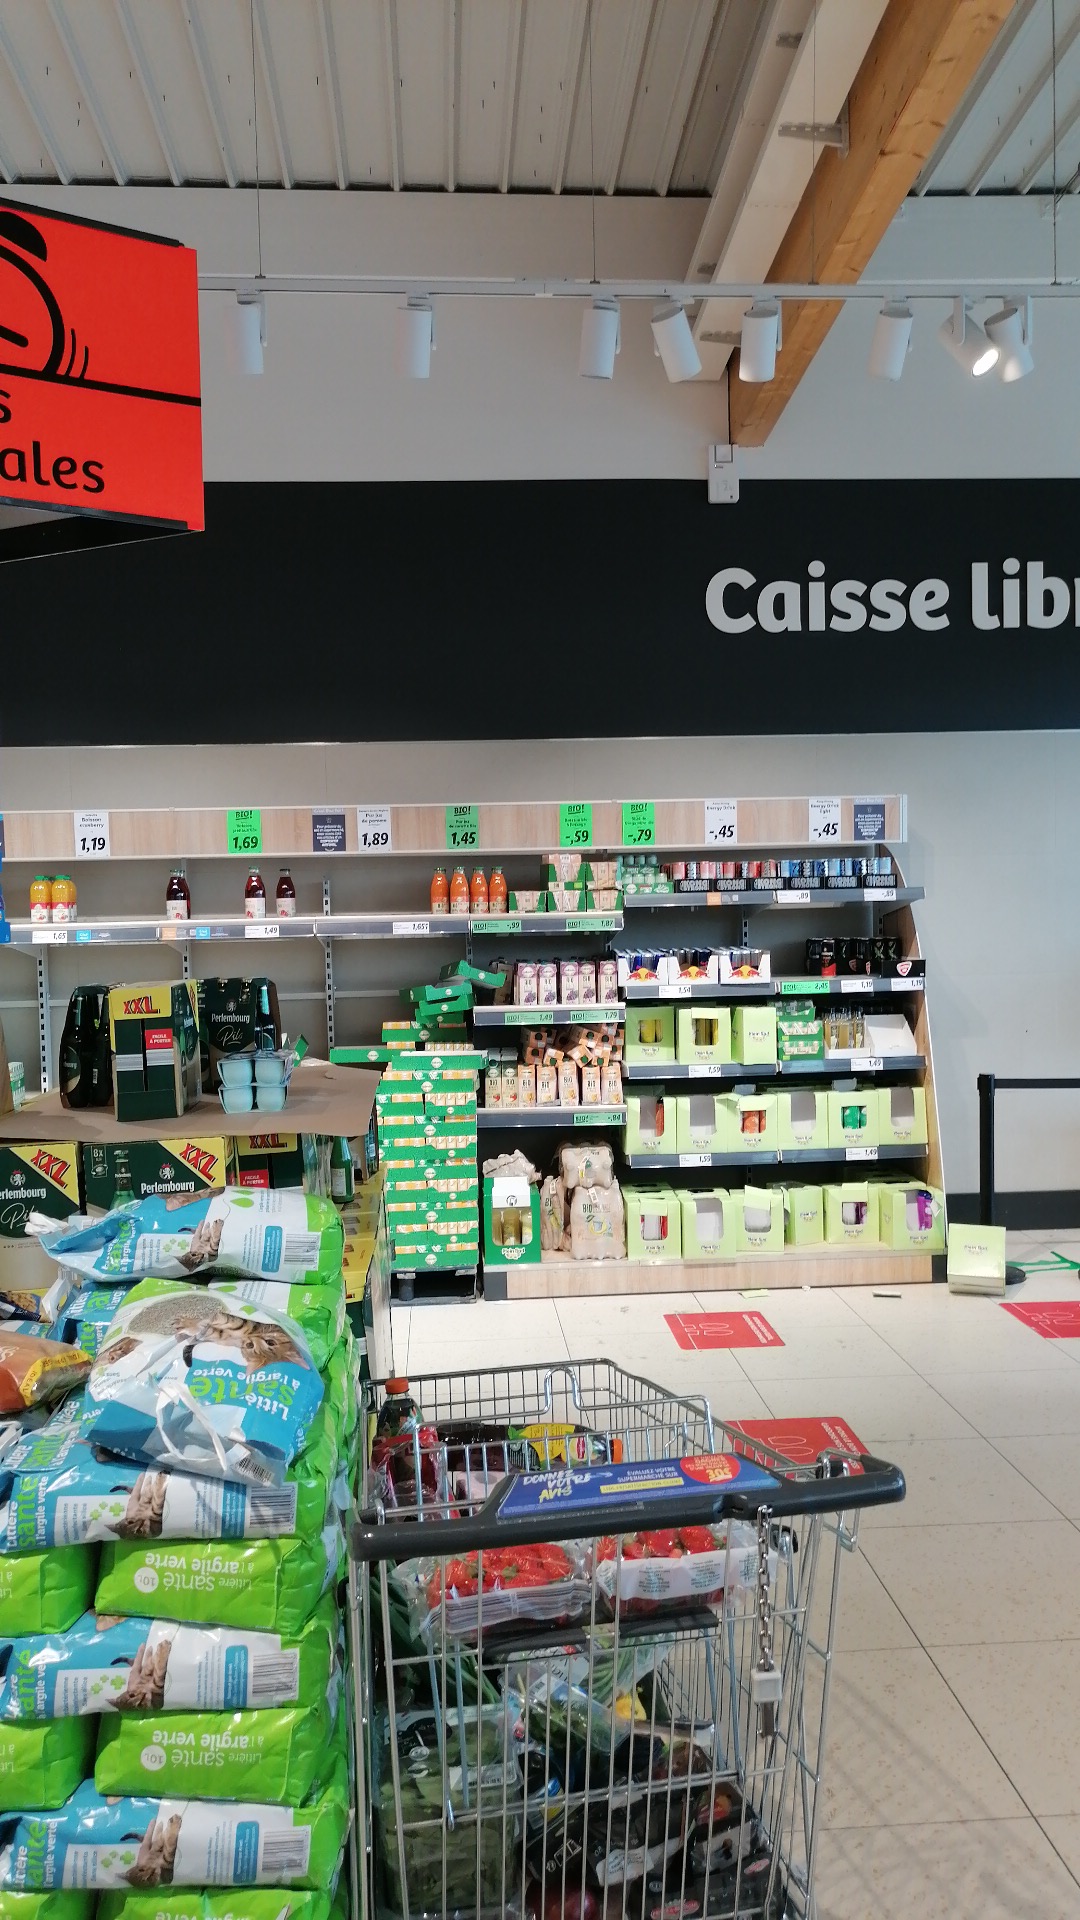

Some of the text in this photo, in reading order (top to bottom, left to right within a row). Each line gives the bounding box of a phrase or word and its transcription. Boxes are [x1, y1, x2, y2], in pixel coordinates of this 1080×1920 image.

[0, 440, 105, 494] ales
[705, 557, 1080, 634] Caisse lib
[235, 810, 253, 820] BIO!
[454, 805, 471, 816] BIO!
[568, 804, 585, 815] BIO!
[630, 803, 648, 814] BIO!
[565, 830, 589, 846] -,59
[627, 828, 652, 844] -,79
[709, 825, 735, 840] -,45
[813, 822, 839, 838] -,45
[80, 837, 106, 853] 1,19
[233, 836, 259, 851] 1,69
[362, 832, 389, 848] 1,89
[451, 832, 477, 846] 1,45
[123, 996, 160, 1015] XXL
[30, 1148, 71, 1190] XXL
[179, 1142, 219, 1183] XXL
[140, 1180, 195, 1195] Perlembourg
[523, 1469, 575, 1486] DONNEZ
[547, 1473, 591, 1489] VOTRE
[539, 1485, 573, 1504] AVIS
[145, 1552, 187, 1569] verte
[163, 1572, 216, 1592] santé
[152, 1729, 196, 1746] verte
[171, 1748, 225, 1768] santé
